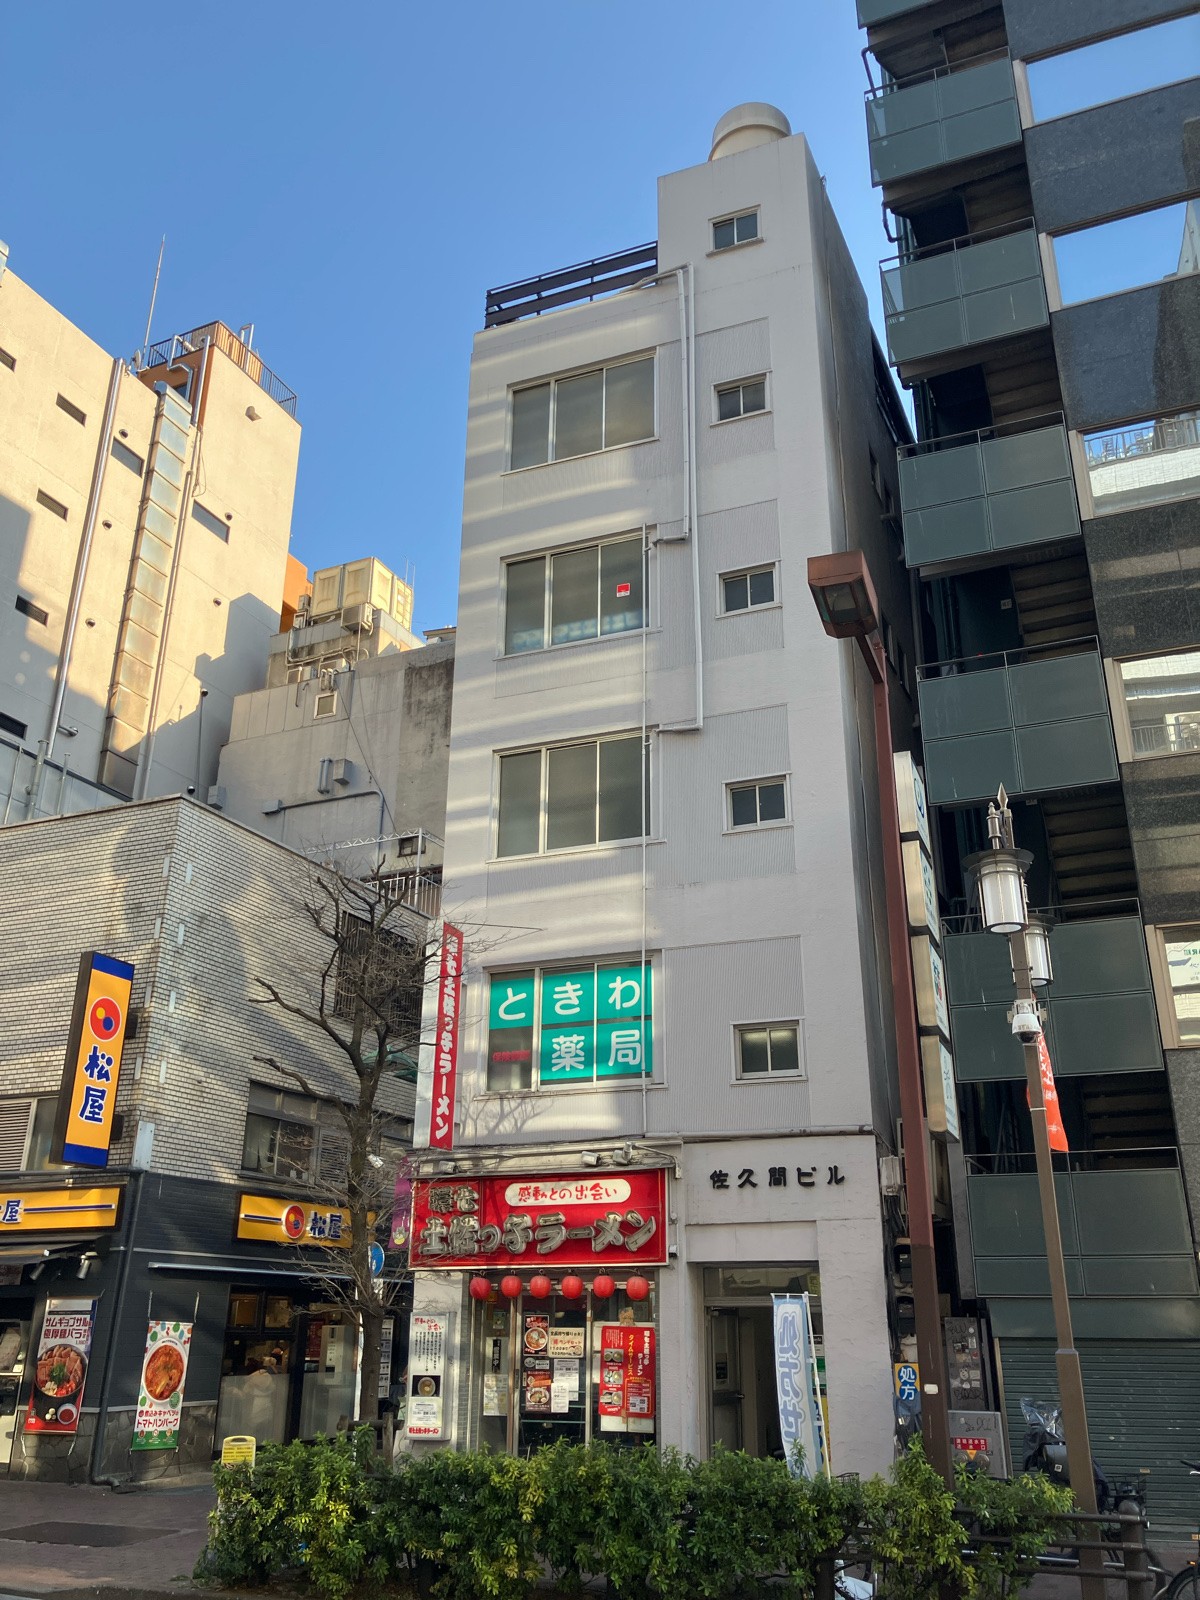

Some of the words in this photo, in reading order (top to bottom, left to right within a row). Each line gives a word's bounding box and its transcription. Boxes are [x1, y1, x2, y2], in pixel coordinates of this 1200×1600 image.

[498, 976, 641, 1021] ときわ
[551, 1029, 642, 1072] 薬局
[79, 1045, 113, 1123] 松屋
[517, 1182, 618, 1202] 感動との出会い
[709, 1165, 845, 1189] 佐久間ビル
[0, 1199, 23, 1224] 屋
[307, 1210, 343, 1240] 松屋
[418, 1210, 657, 1256] 土佐っ子ラーメン
[899, 1367, 916, 1401] 処方
[136, 1418, 179, 1429] トマトハンバーグ
